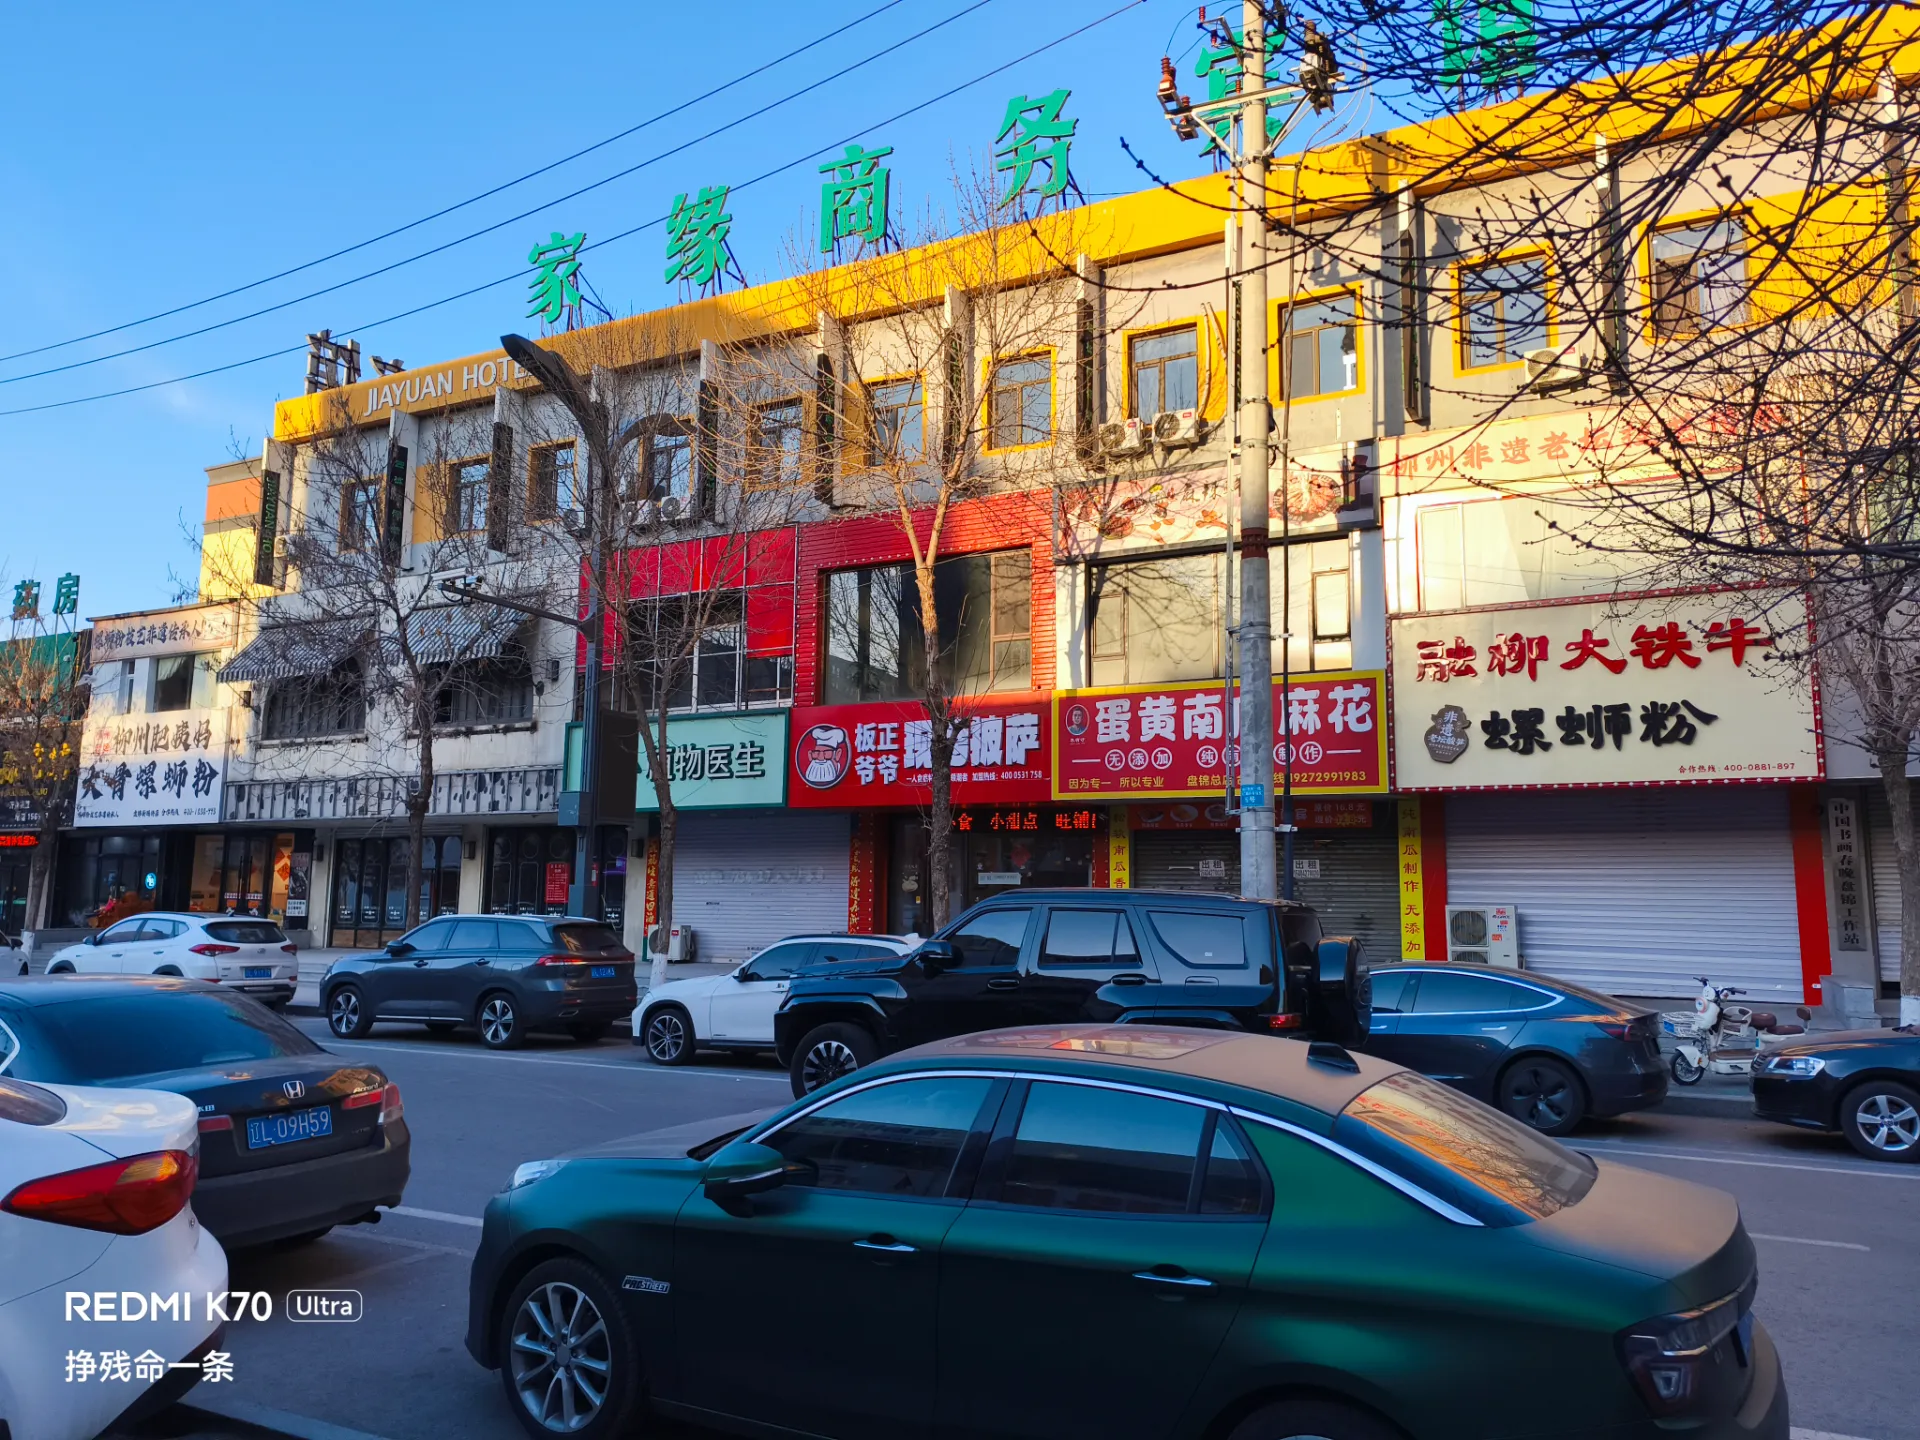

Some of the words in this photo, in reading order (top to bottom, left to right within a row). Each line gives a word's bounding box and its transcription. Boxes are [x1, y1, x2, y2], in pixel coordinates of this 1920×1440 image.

[363, 369, 453, 417] JIAYUAN
[463, 354, 539, 391] HOTE
[1416, 618, 1773, 683] 融柳大铁牛
[1095, 683, 1373, 744] 蛋黄南麻花
[1480, 699, 1719, 756] 螺蛳粉
[855, 722, 899, 753] 板正
[854, 754, 899, 786] 爷爷
[1107, 749, 1171, 770] 无添加
[1200, 746, 1320, 766] 纯南制作
[1724, 762, 1796, 772] 400-0881-897
[80, 758, 219, 801] 大骨螺蛳粉
[1068, 777, 1111, 790] 因为专一
[1119, 776, 1164, 788] 所以专业
[1202, 859, 1222, 869] 出租
[1295, 860, 1317, 869] 出租
[1404, 904, 1421, 953] 无添加
